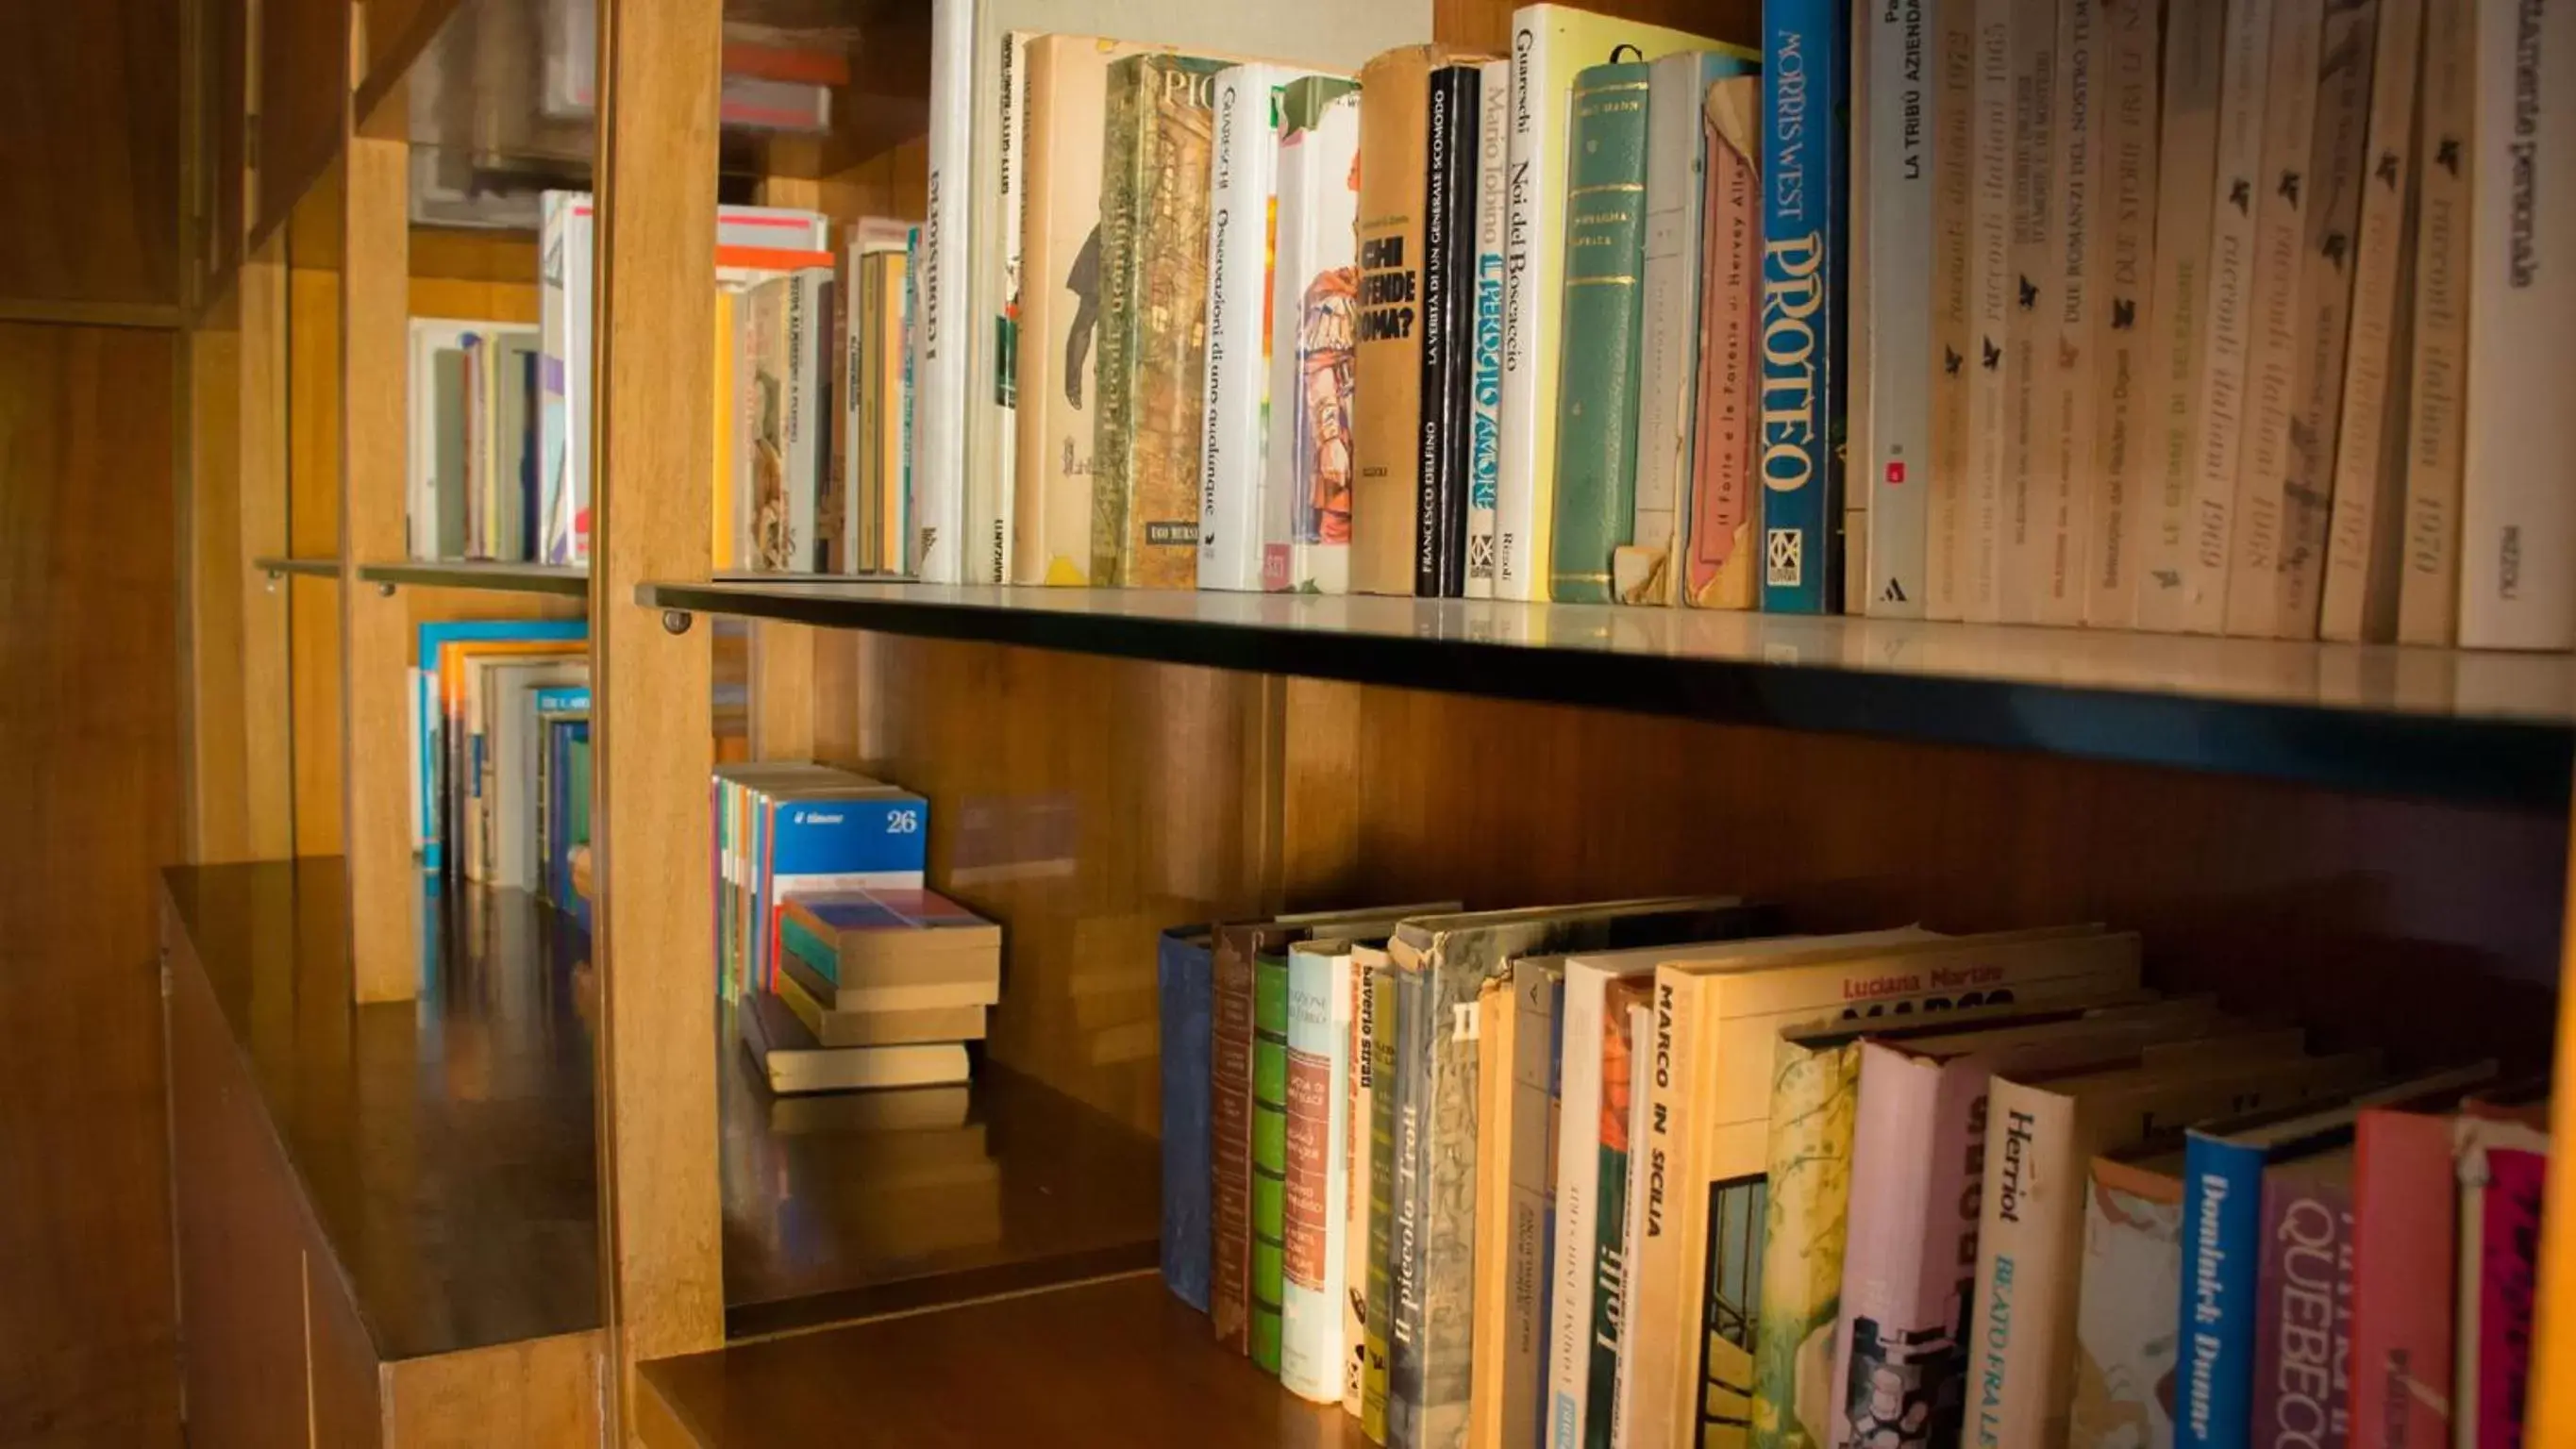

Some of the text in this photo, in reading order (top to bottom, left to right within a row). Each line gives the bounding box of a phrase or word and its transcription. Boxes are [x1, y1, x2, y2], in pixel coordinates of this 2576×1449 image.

[1482, 86, 1505, 244] Mario Tobino
[1900, 90, 1919, 149] TRIBÙ
[1904, 154, 1919, 180] LA
[1981, 100, 2004, 200] italiani
[1428, 89, 1446, 365] LA VERITÀ DI UN GENERALE SCOMODO
[1507, 27, 1534, 372] Guareschi Noi del Boscaccio
[1212, 208, 1230, 334] Osservazioni
[1362, 236, 1404, 270] CHI
[1478, 253, 1504, 278] IL
[1762, 29, 1822, 491] MORRIS WEST PROTEO
[1210, 364, 1219, 404] uno
[1211, 342, 1224, 360] di
[1717, 452, 1733, 504] Forte
[1729, 216, 1746, 286] Hervey
[1204, 408, 1221, 517] qualunque
[1422, 421, 1435, 574] FRANCESCO DELFINO
[1472, 410, 1498, 511] AMORE
[885, 808, 918, 834] 26
[1843, 975, 1921, 999] Luciana
[1647, 982, 1674, 1239] MARCO IN SICILIA
[1999, 1107, 2035, 1224] Herriot
[1397, 1199, 1419, 1312] piccolo
[1597, 1244, 1622, 1357] Lolli
[1987, 1254, 2015, 1349] BEATO
[2190, 1173, 2230, 1441] Dominick Dunne
[1395, 1318, 1412, 1344] Il
[1982, 1350, 2006, 1407] FRA
